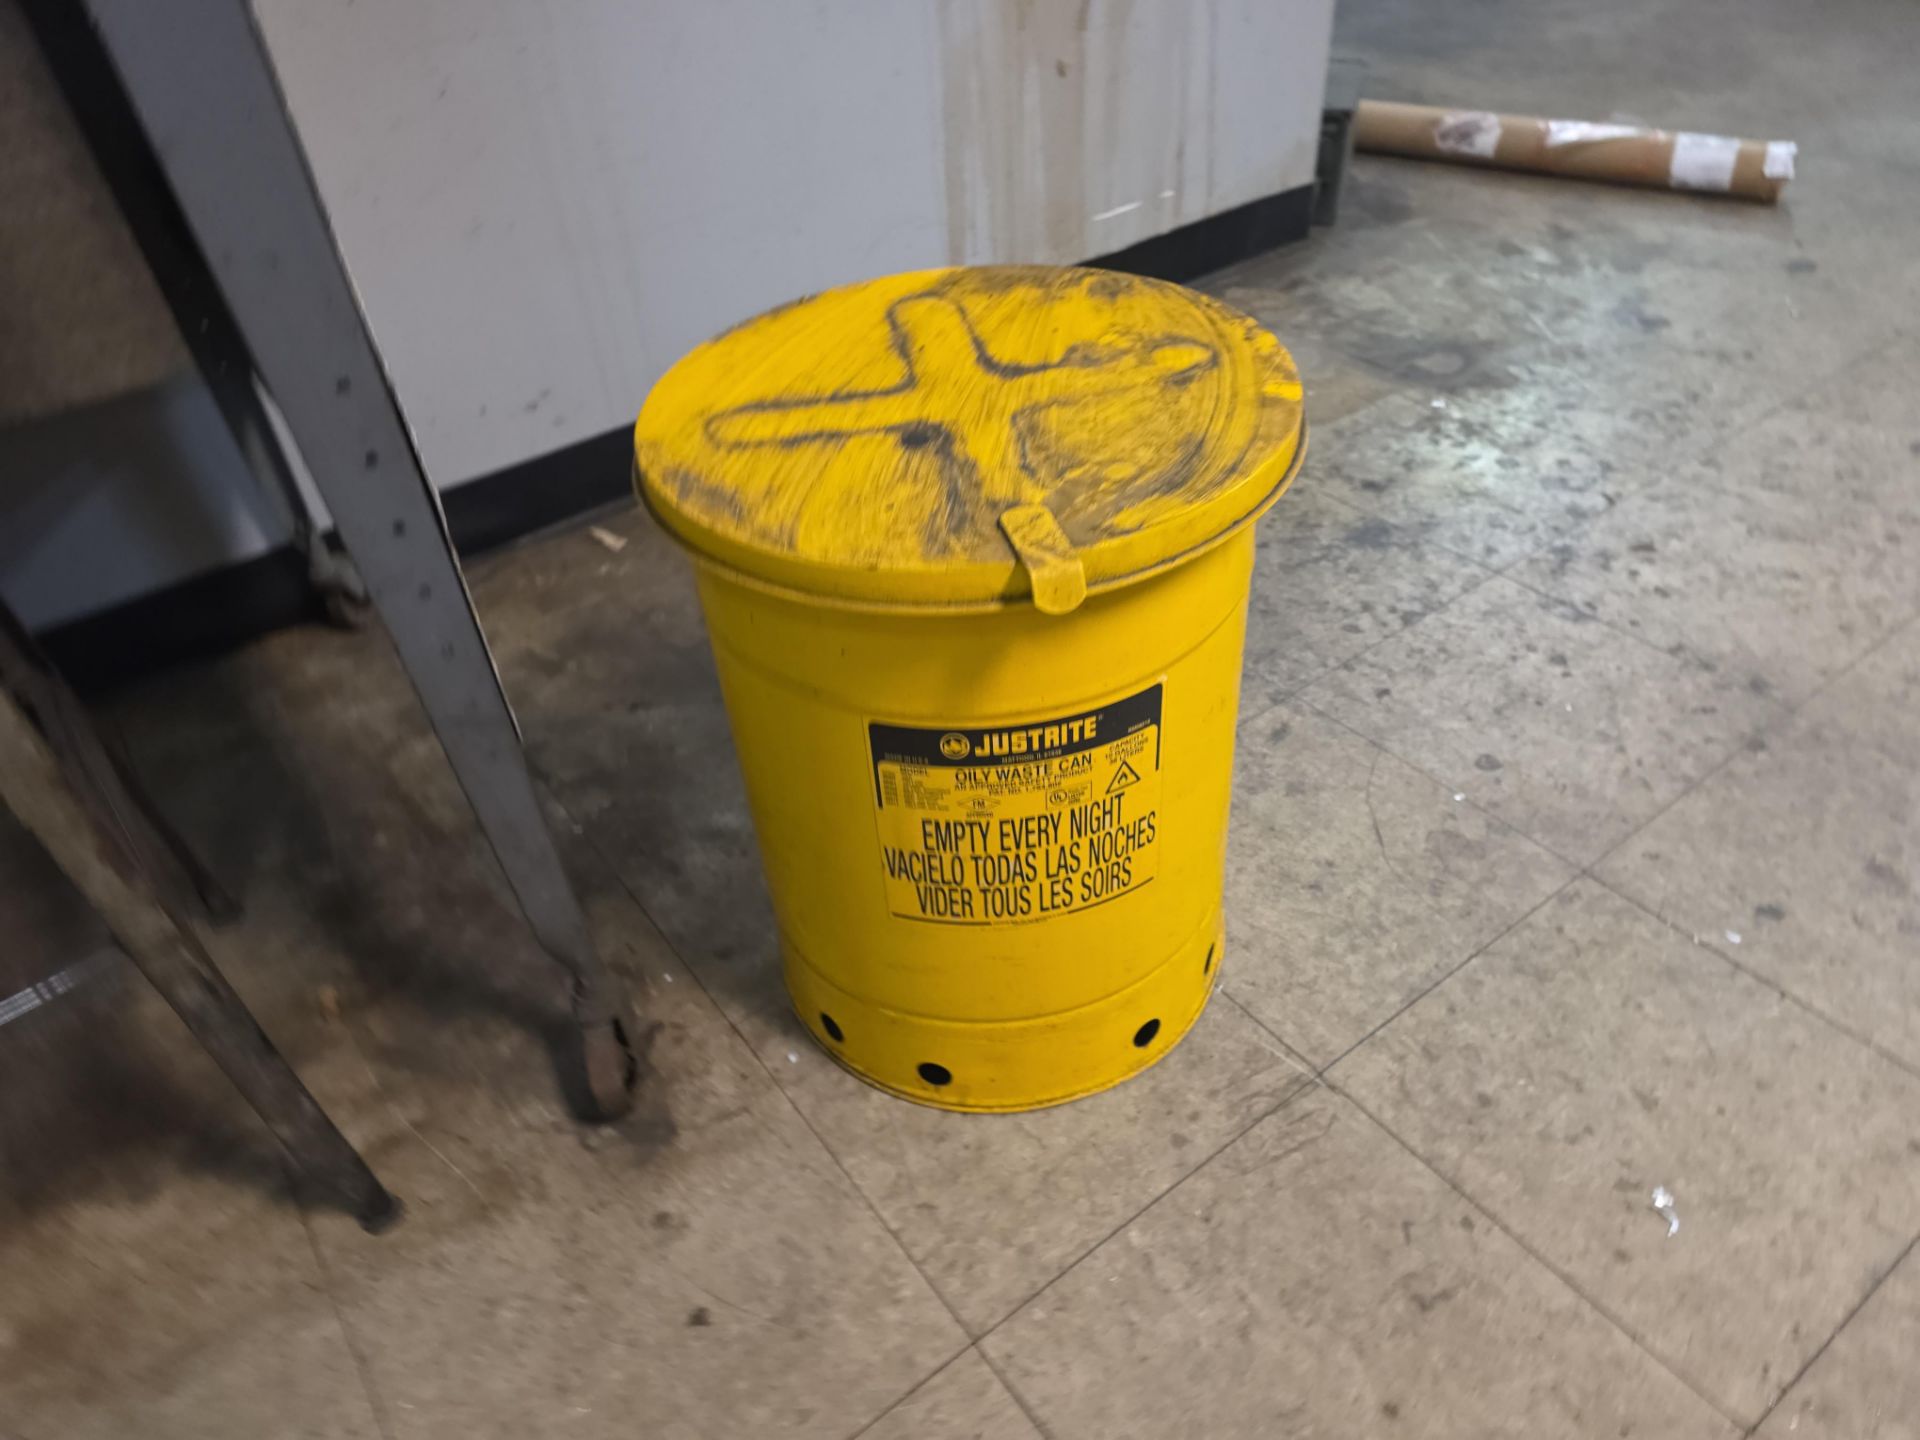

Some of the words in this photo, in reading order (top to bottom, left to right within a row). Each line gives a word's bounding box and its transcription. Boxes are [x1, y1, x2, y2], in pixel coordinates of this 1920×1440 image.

[955, 766, 992, 782] OILY
[997, 762, 1052, 781] WASTE
[1059, 752, 1092, 772] CAN
[975, 716, 1097, 757] JUSTRITE
[884, 846, 964, 886] VACIELO
[971, 850, 1037, 886] TODAS
[1046, 843, 1080, 877] LAS
[1089, 811, 1156, 868] NOCHES
[921, 816, 990, 854] EMPTY
[1000, 812, 1062, 852] EVERY
[1071, 792, 1125, 839] NIGHT
[916, 884, 974, 918] VIDER
[980, 883, 1032, 918] TOUS
[1039, 877, 1073, 912] LES
[1080, 856, 1132, 901] SOIRS
